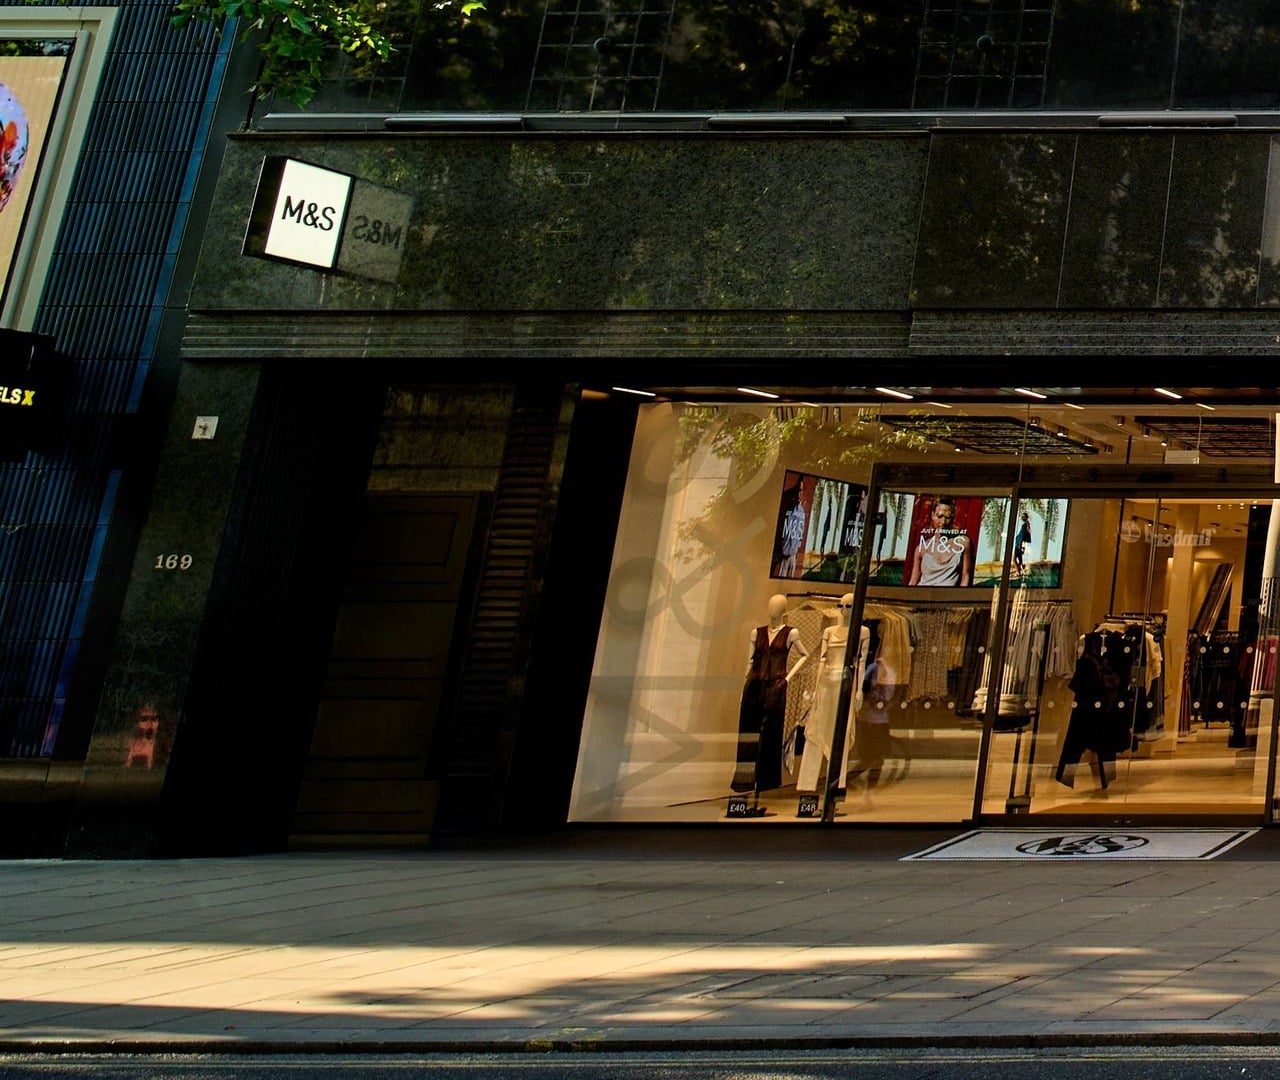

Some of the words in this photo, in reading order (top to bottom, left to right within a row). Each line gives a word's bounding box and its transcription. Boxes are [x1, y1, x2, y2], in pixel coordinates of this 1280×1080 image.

[281, 195, 336, 231] M&S
[918, 534, 966, 554] M&S
[155, 554, 193, 570] 169
